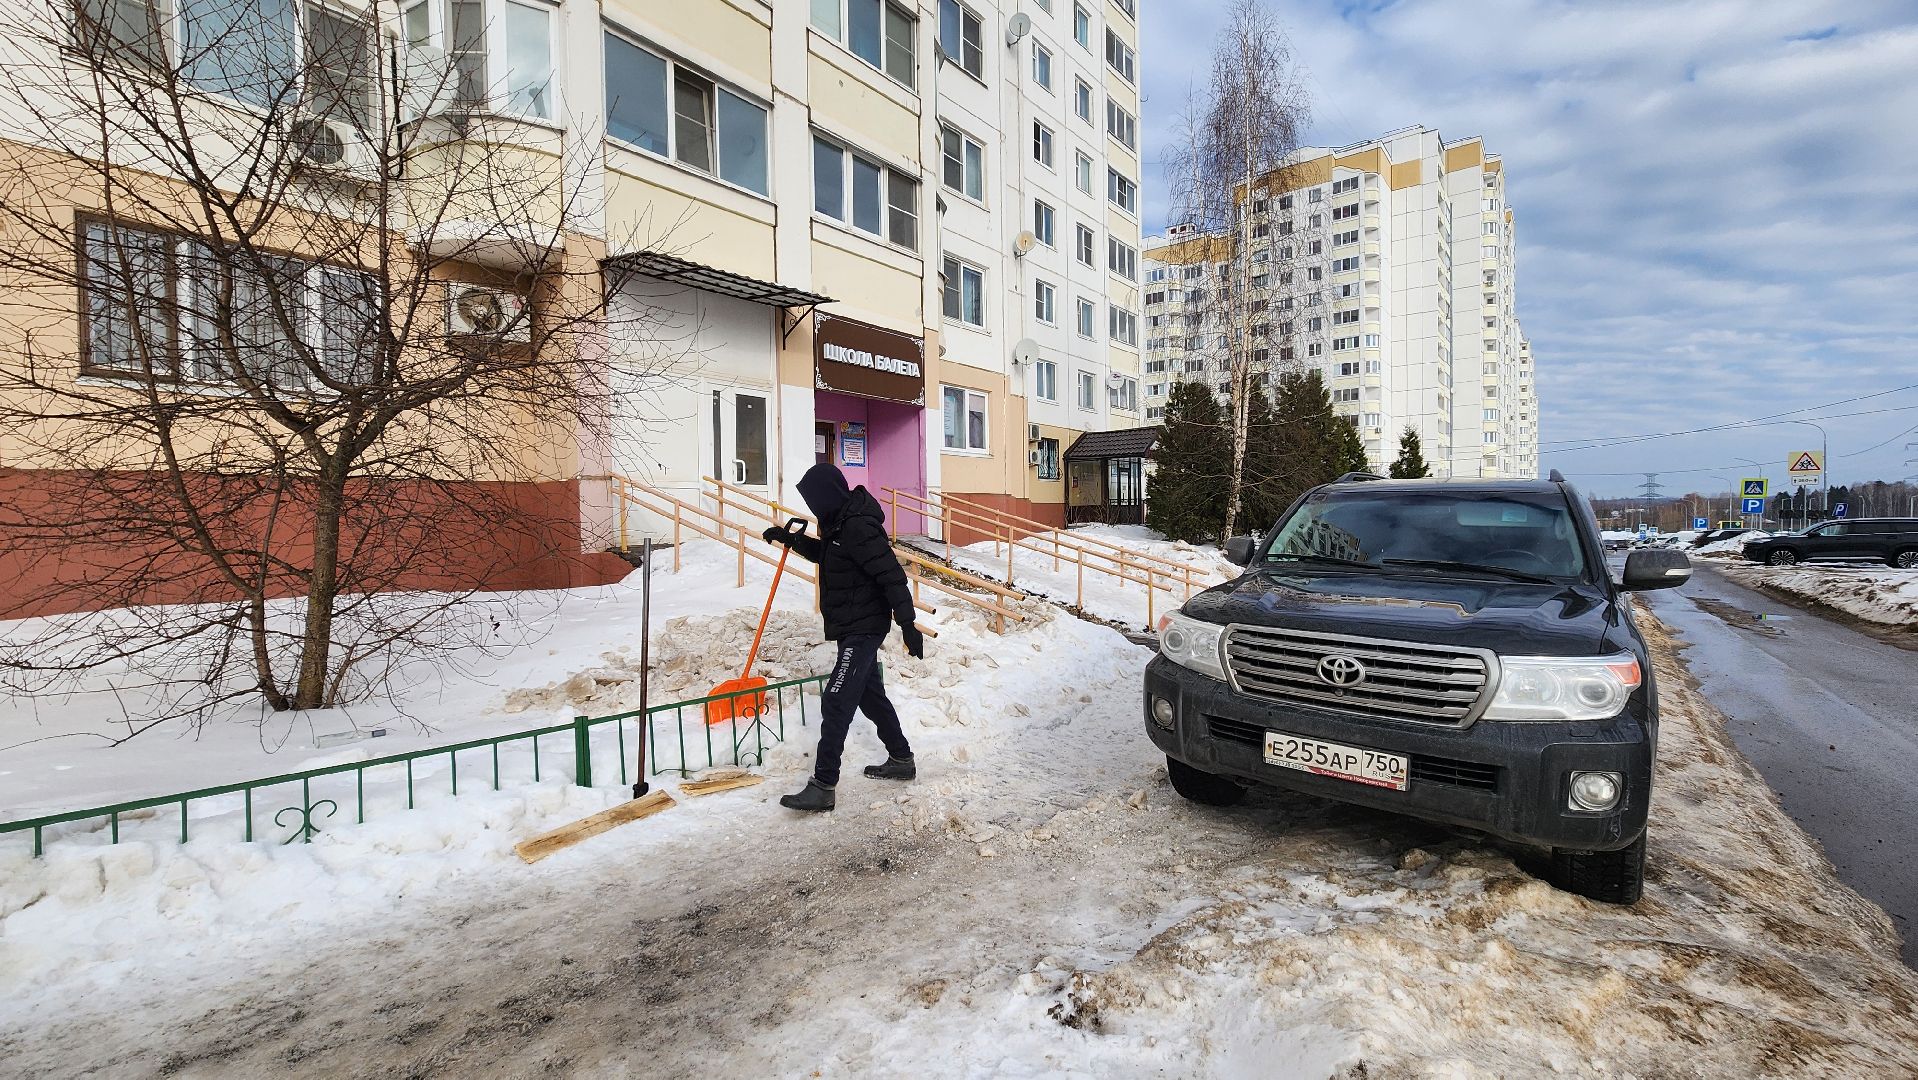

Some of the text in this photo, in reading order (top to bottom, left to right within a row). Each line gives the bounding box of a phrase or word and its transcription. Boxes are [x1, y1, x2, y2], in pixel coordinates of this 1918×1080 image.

[823, 343, 921, 378] ШКОЛА БАЛЕТА
[1748, 500, 1759, 511] P
[1364, 752, 1400, 774] 750
[1372, 770, 1392, 780] RUS
